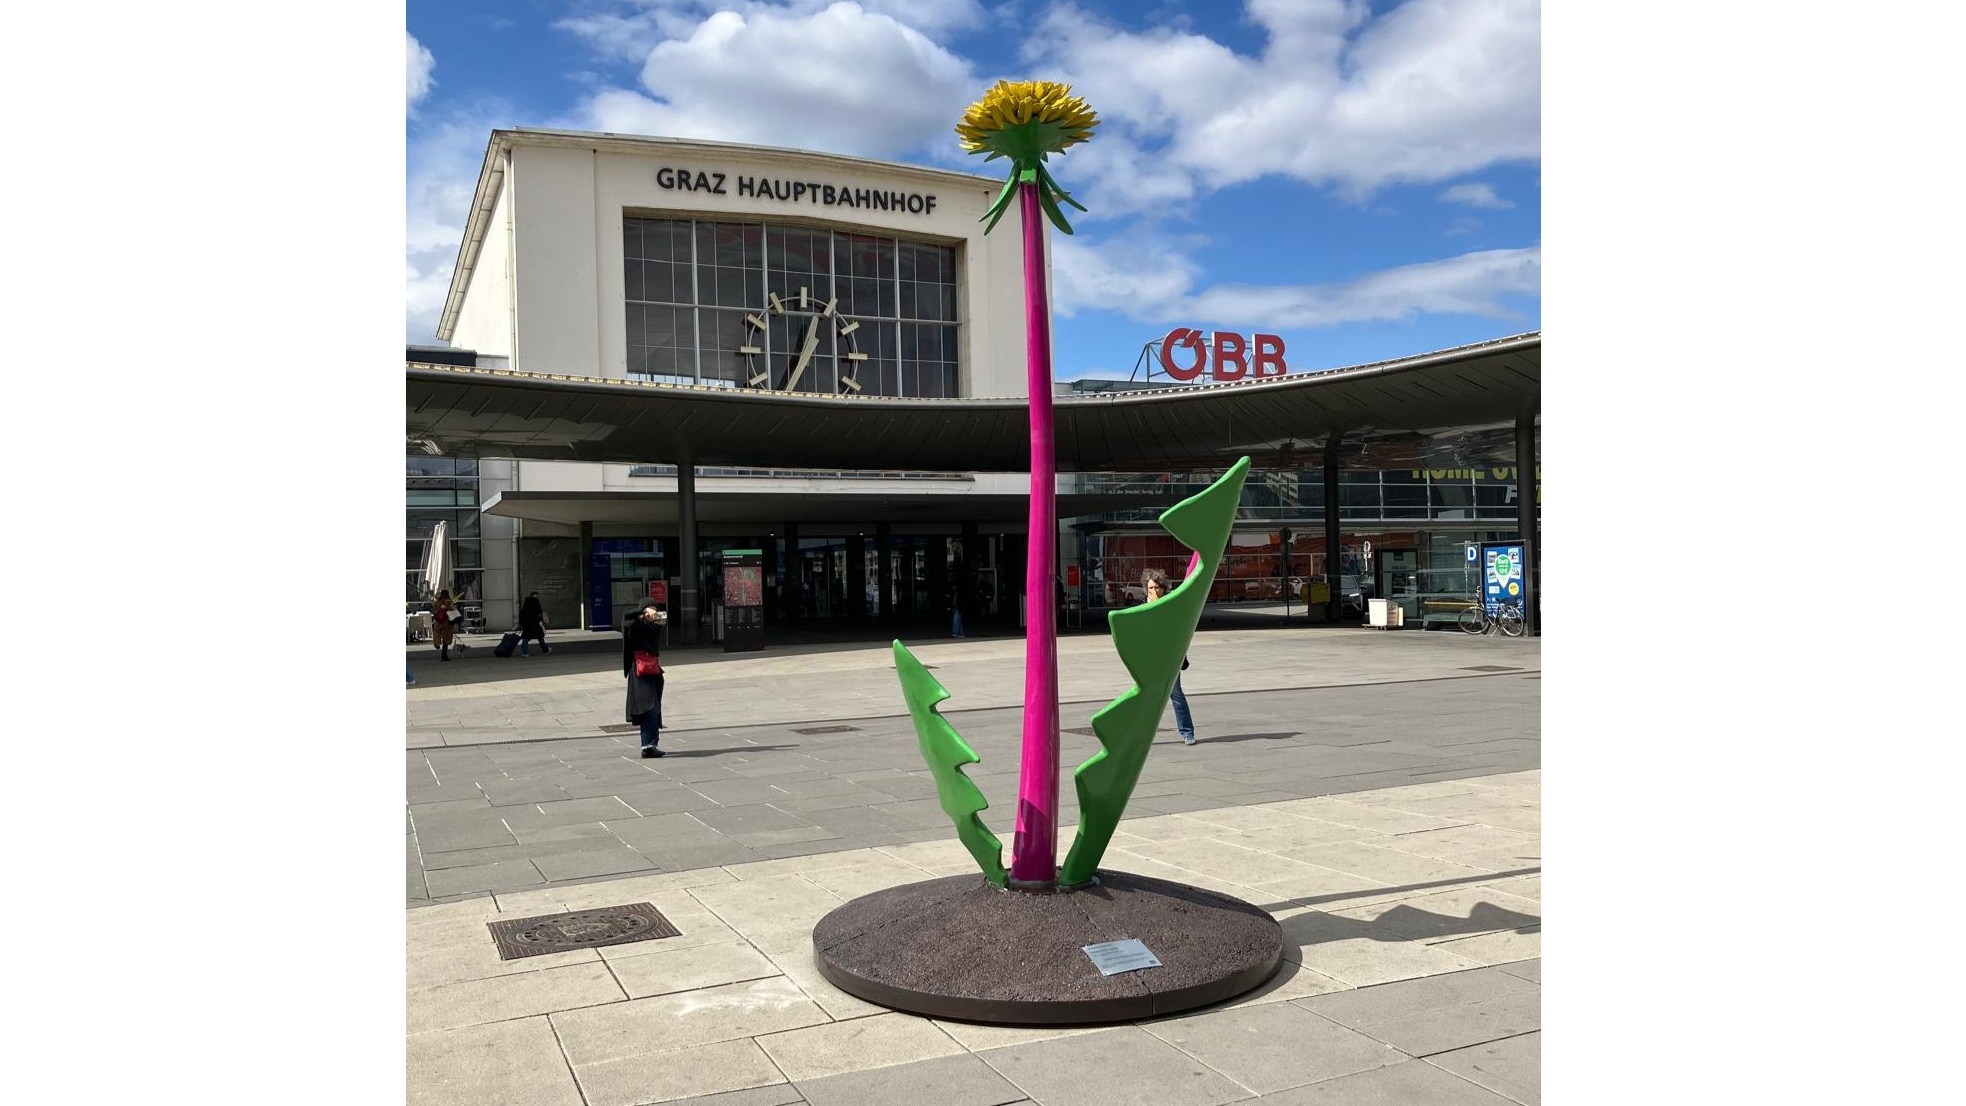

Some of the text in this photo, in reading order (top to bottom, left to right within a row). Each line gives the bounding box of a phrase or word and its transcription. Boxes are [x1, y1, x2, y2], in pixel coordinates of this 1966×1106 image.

[656, 167, 937, 215] GRAZ HAUPTBAHNHOF
[1160, 327, 1287, 381] ÖBB
[1467, 546, 1477, 561] D
